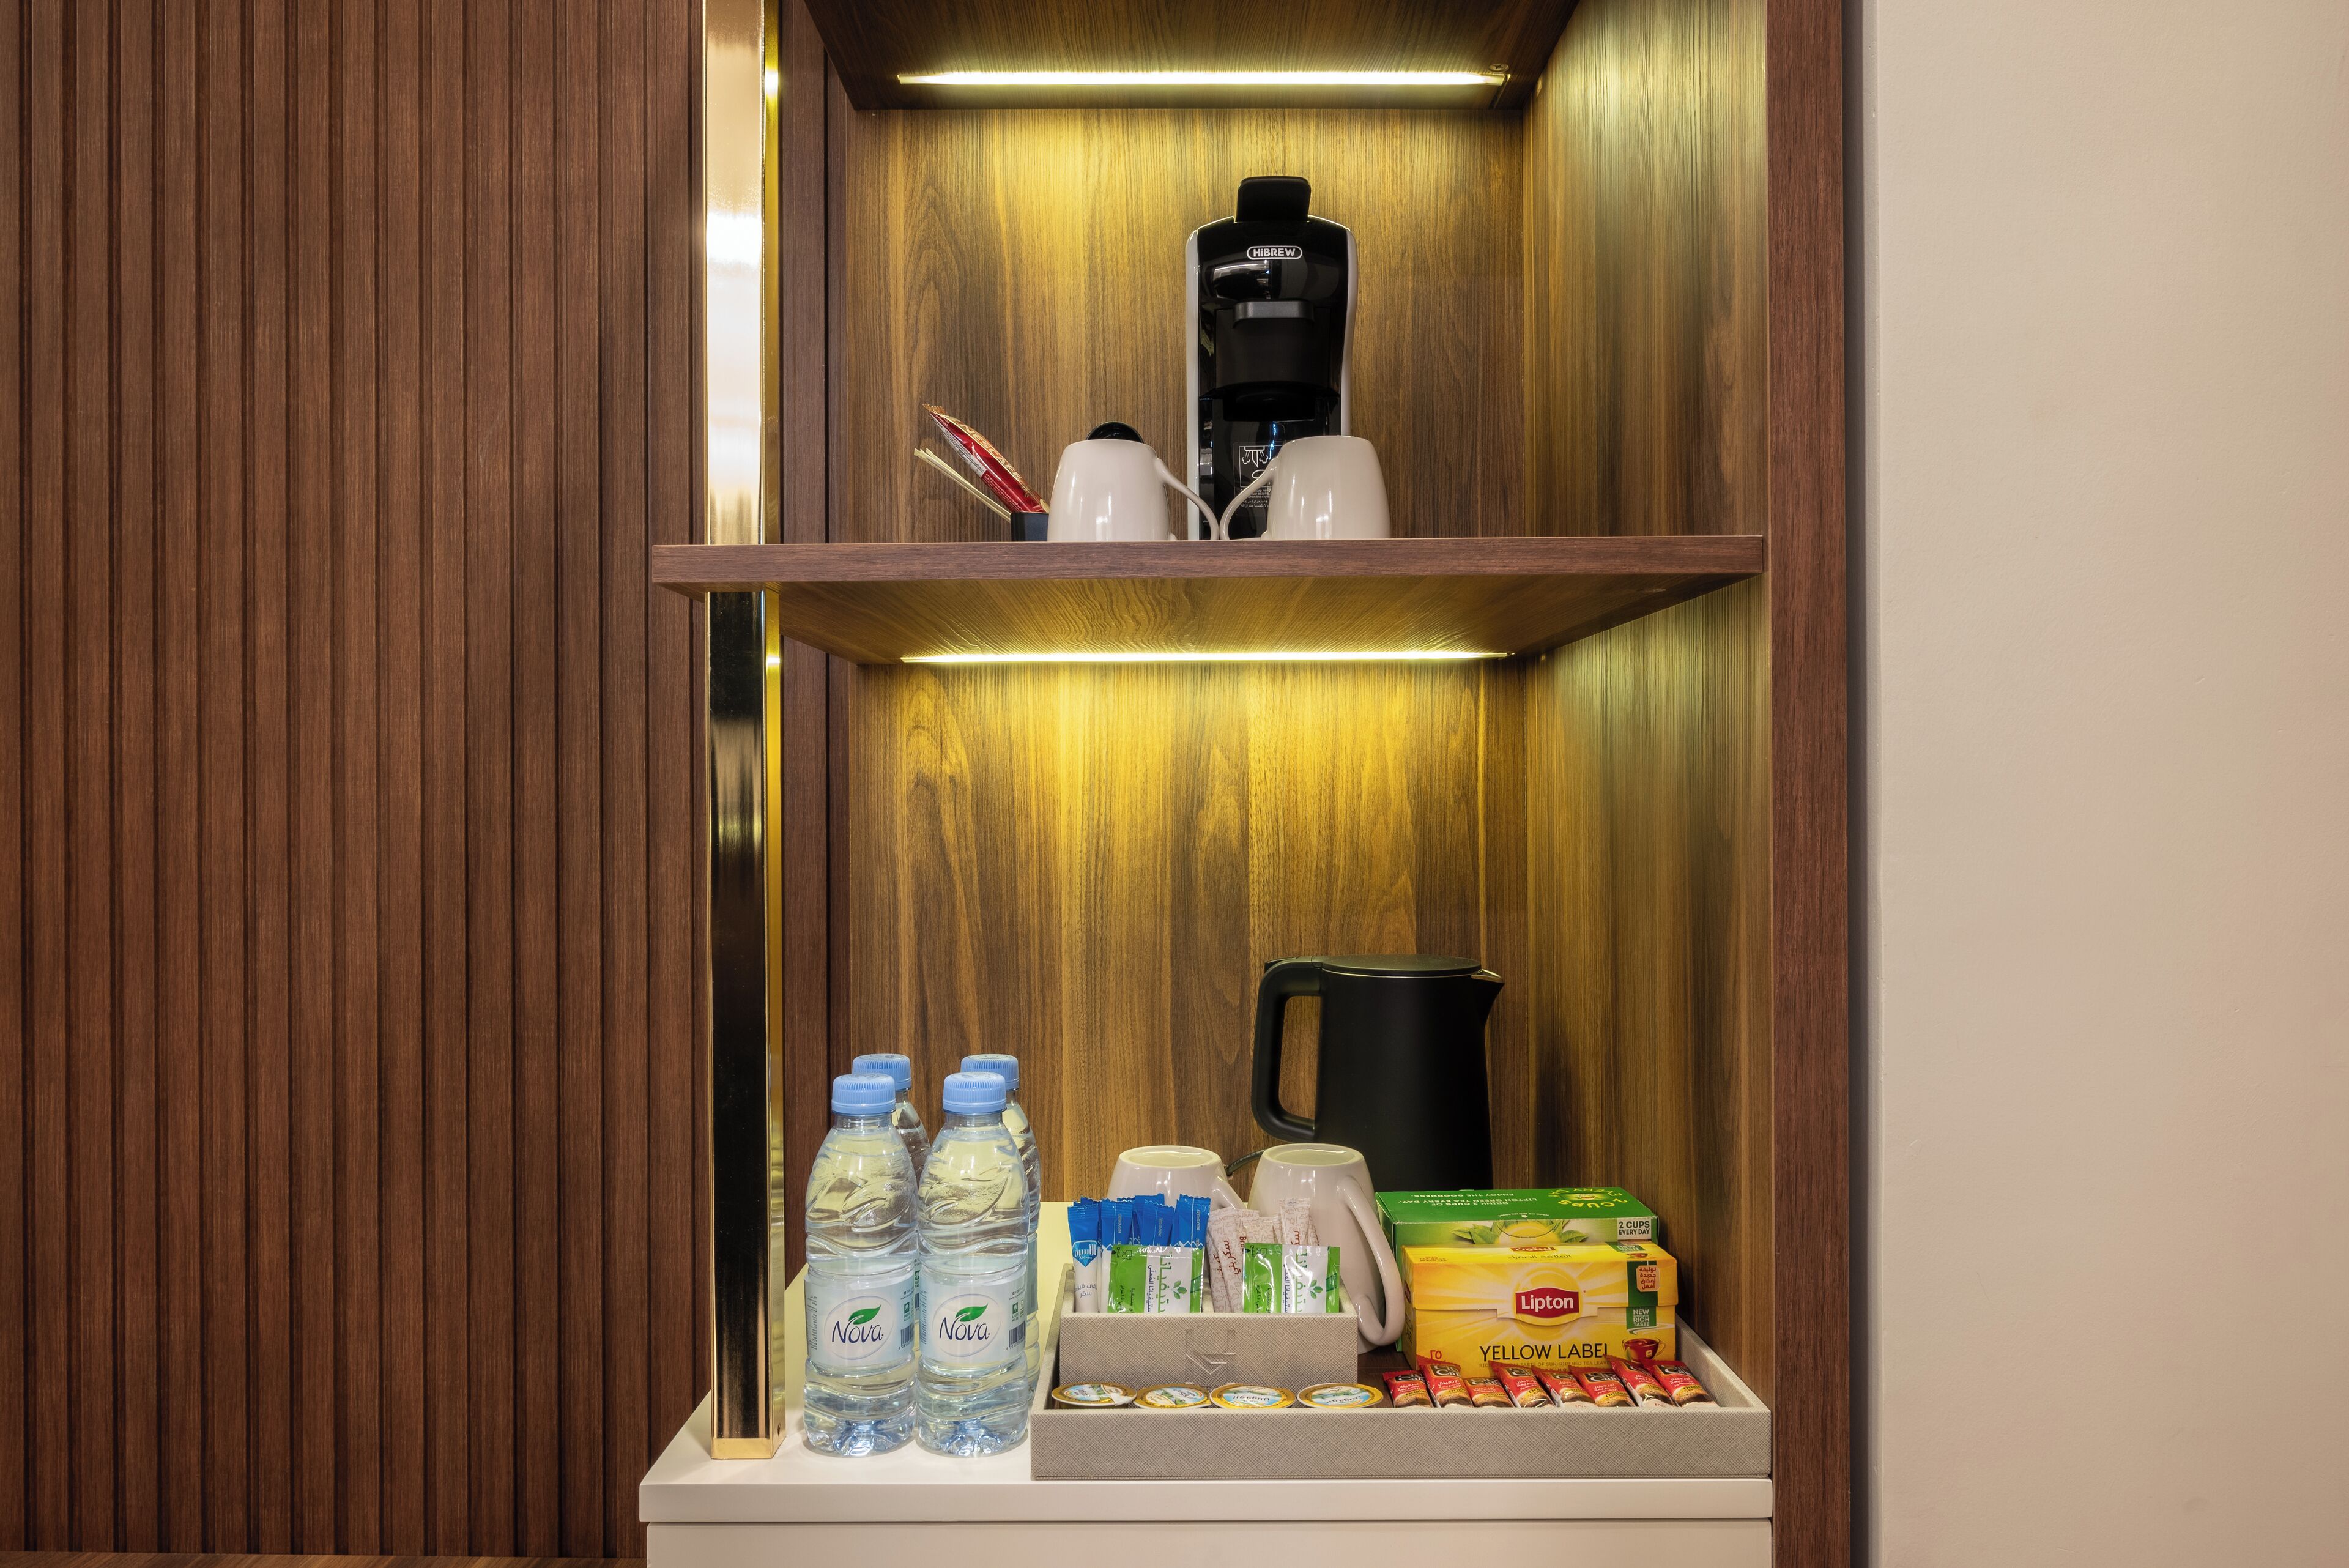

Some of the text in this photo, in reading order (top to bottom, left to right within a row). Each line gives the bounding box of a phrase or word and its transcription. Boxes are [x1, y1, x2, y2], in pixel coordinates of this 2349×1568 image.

[1521, 1293, 1574, 1312] Lipton
[832, 1319, 883, 1343] Nova
[940, 1316, 990, 1340] Nova
[1479, 1344, 1551, 1361] YELLOW
